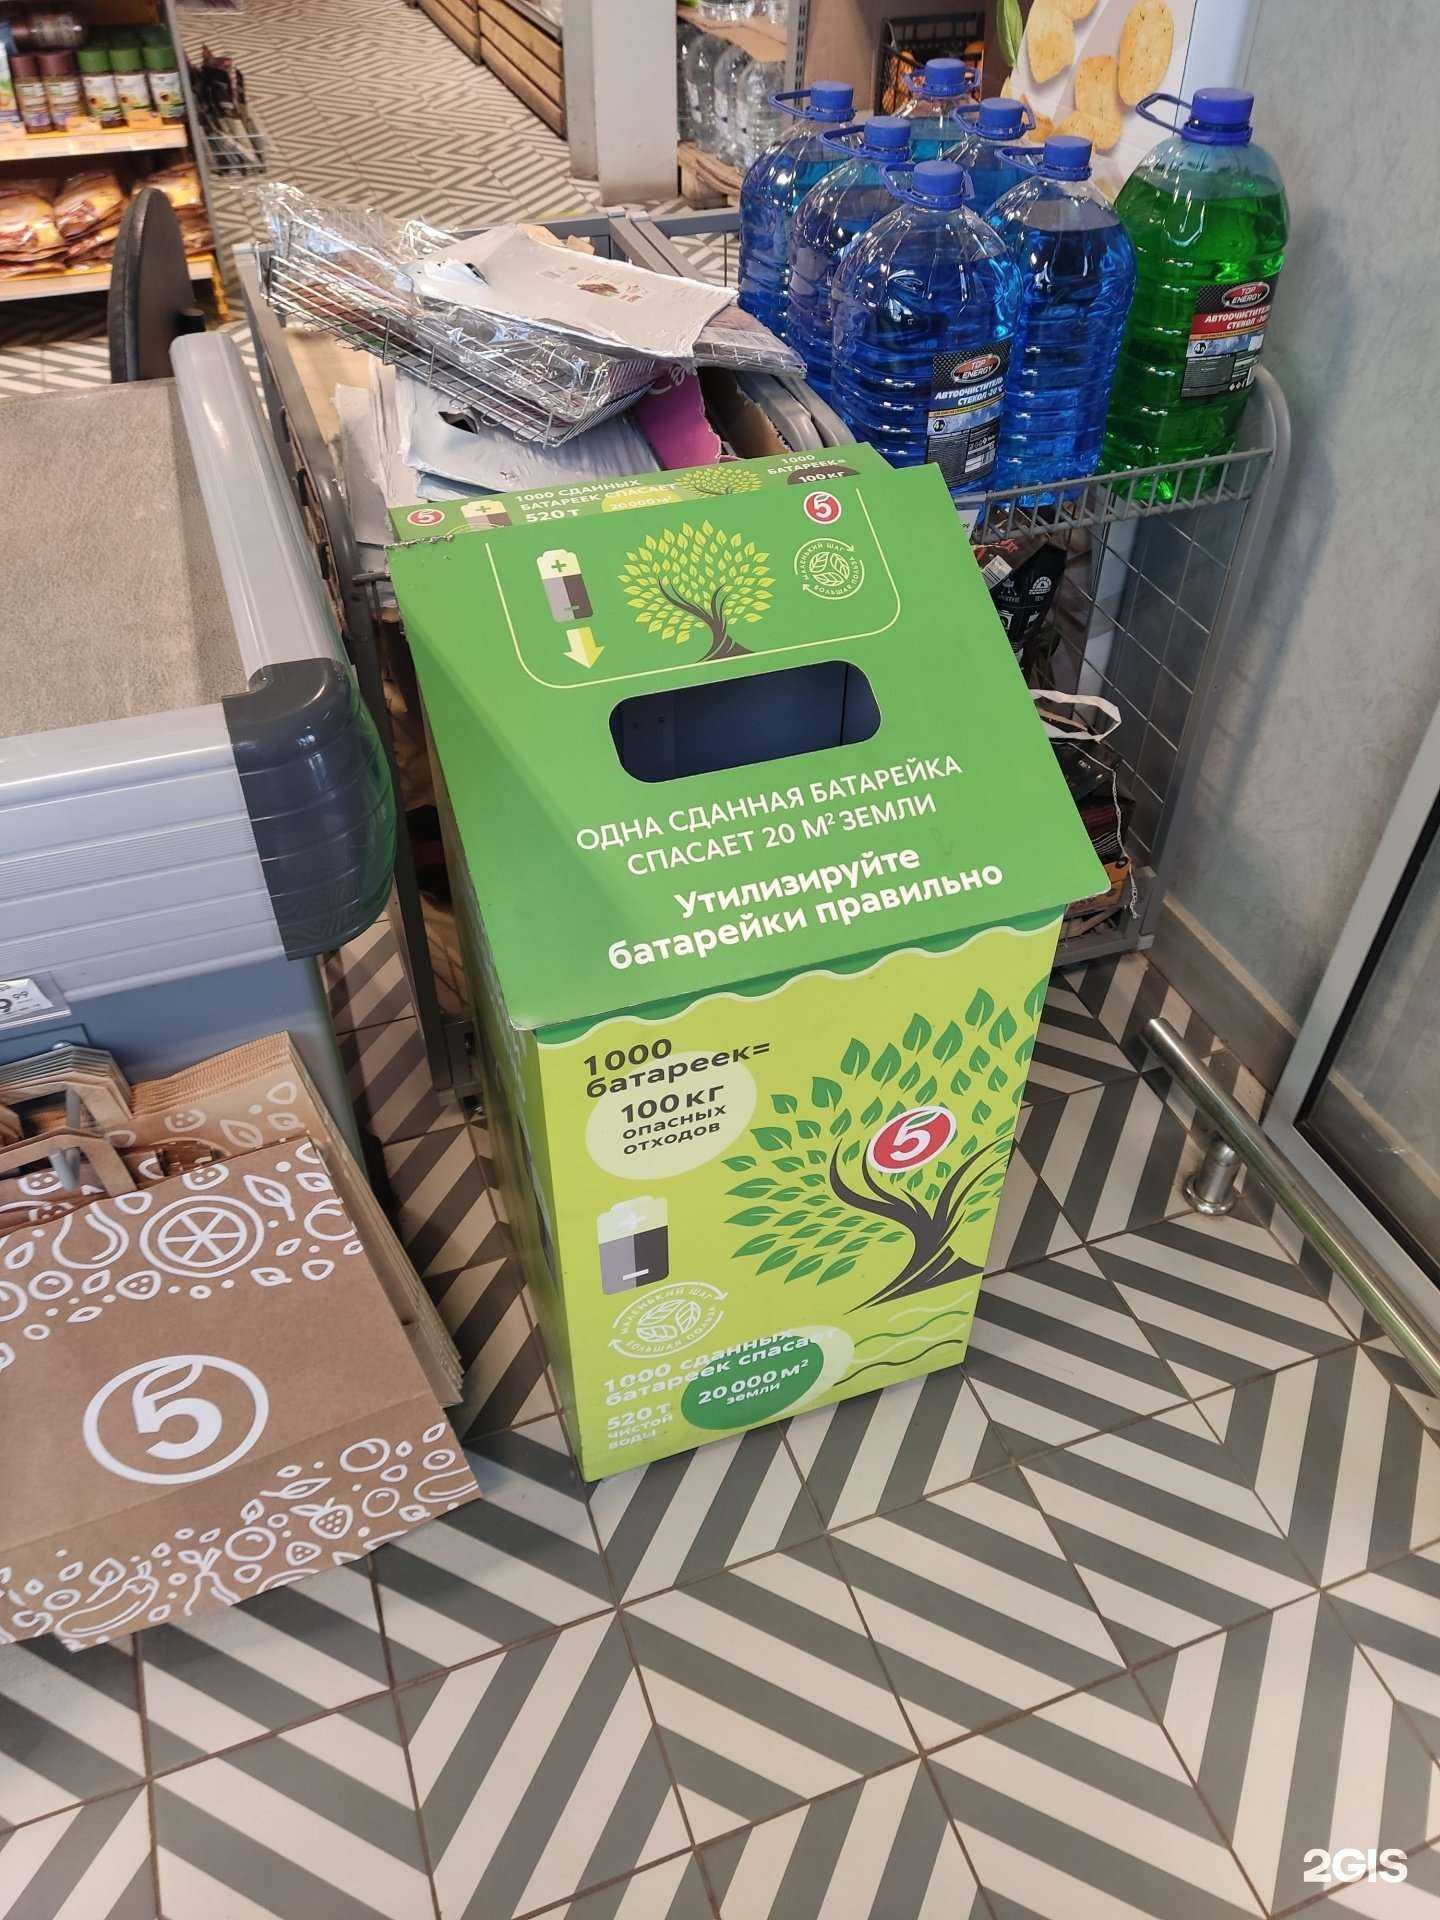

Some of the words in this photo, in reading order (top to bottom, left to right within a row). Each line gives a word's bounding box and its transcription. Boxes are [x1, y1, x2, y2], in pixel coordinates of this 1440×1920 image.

[1231, 292, 1263, 304] ENERGY
[1241, 286, 1257, 296] TOP
[962, 364, 993, 379] ENERGY
[971, 359, 987, 370] TOP
[934, 376, 1004, 400] АВТООЧИСТИТЕЛЬ
[957, 391, 988, 406] СТЕКОЛ
[781, 454, 816, 464] 1000
[515, 491, 555, 502] 1000
[558, 479, 641, 497] СДАННЫХ
[798, 473, 826, 483] 100
[519, 493, 601, 511] БАТАРЕЕК
[602, 482, 677, 499] СПАСАЕТ
[525, 510, 566, 524] 520
[575, 815, 664, 851] ОДНА
[668, 786, 806, 833] СДАННАЯ
[809, 754, 963, 804] БАТАРЕЙКА
[626, 829, 755, 877] СПАСАЕТ
[764, 826, 796, 849] 20
[840, 793, 938, 832] ЗЕМЛИ
[673, 848, 921, 920] Утилизируйте
[607, 906, 809, 970] батарейки
[815, 865, 1004, 926] правильно
[584, 1038, 673, 1076] 1000
[586, 1042, 770, 1098] батареек=
[621, 1093, 680, 1124] 100
[686, 1084, 725, 1109] кг
[622, 1104, 727, 1140] опасных
[623, 1122, 721, 1155] отходов
[603, 1363, 672, 1393] 1000
[679, 1331, 795, 1370] сданных
[605, 1360, 731, 1407] батареек
[726, 1382, 781, 1406] земли
[607, 1407, 653, 1431] 520
